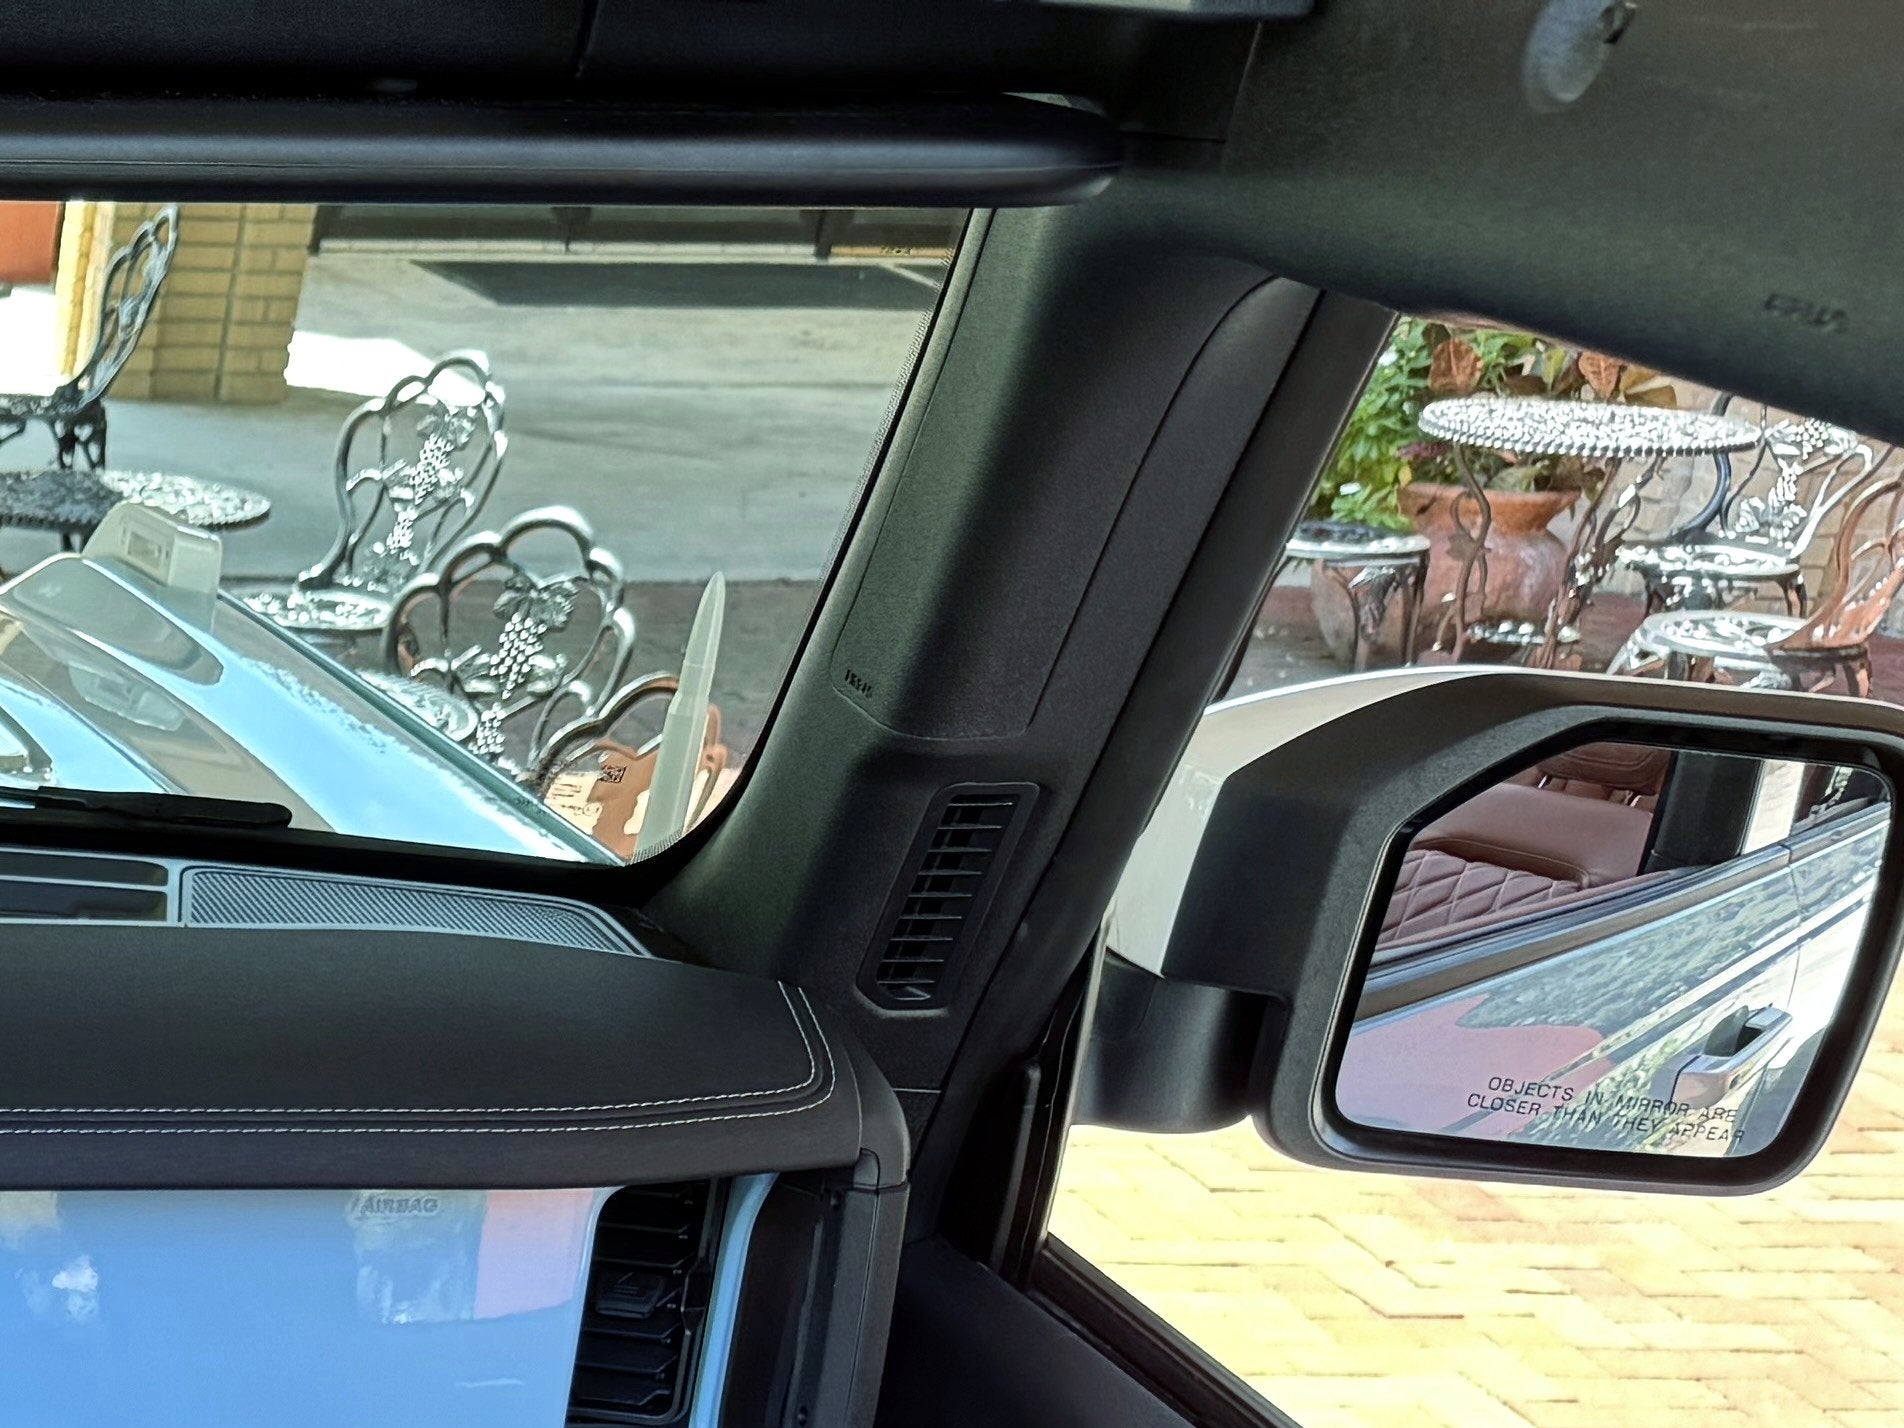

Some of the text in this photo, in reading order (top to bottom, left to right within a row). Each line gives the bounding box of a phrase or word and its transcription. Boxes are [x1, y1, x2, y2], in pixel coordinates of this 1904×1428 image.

[1467, 1093, 1744, 1142] CLOSER THAN THEY APPEAR
[1488, 1076, 1738, 1123] OBJECTS IN MIRROR ARE
